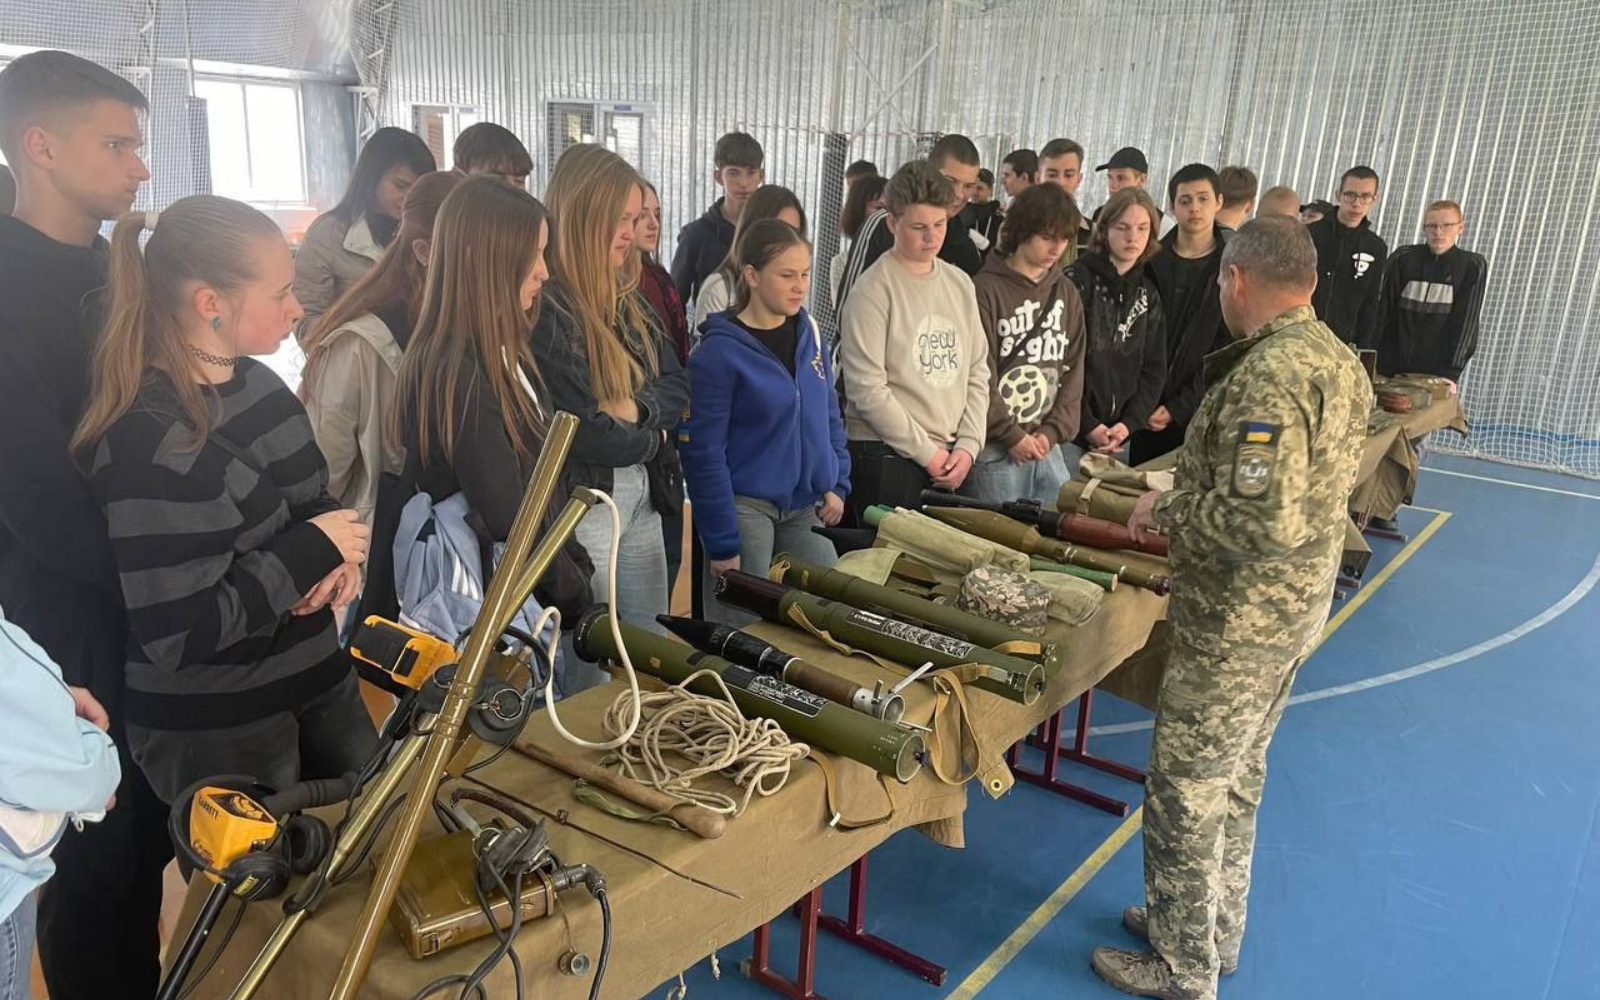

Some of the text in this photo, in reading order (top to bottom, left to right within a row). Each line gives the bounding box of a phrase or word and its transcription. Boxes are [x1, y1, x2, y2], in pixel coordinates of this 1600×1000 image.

[998, 300, 1040, 337] out
[919, 332, 955, 349] new
[920, 350, 957, 374] york
